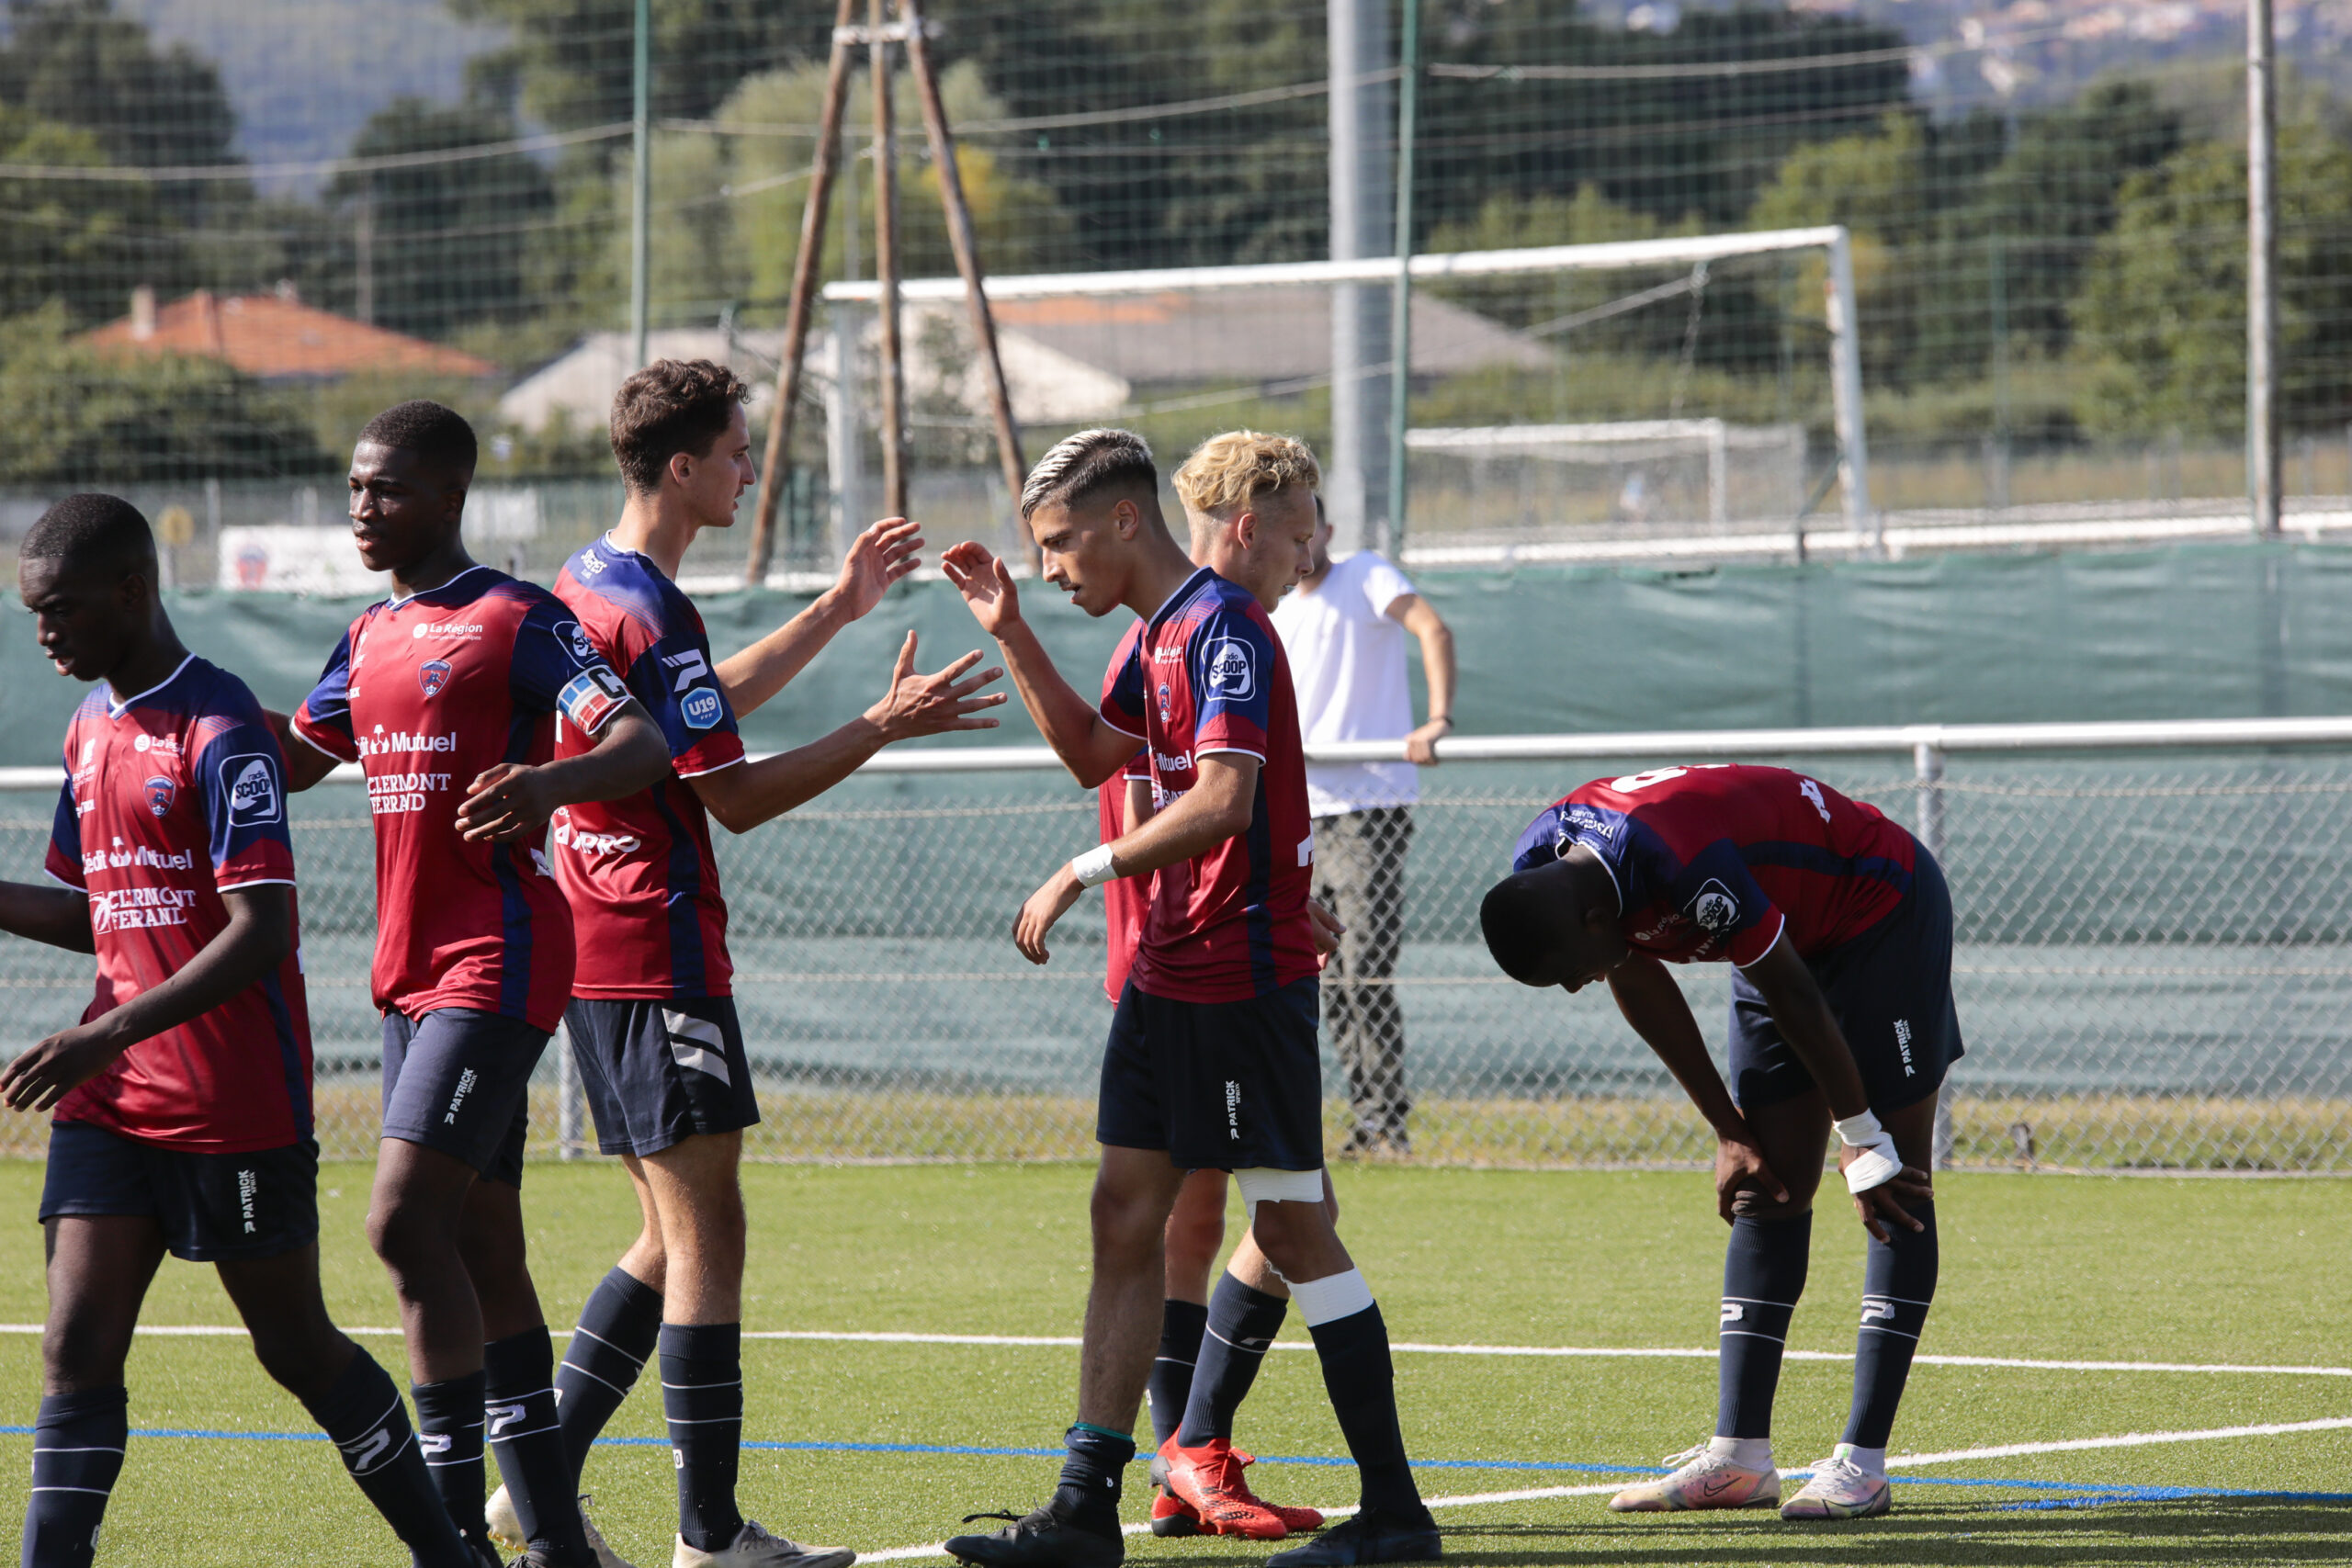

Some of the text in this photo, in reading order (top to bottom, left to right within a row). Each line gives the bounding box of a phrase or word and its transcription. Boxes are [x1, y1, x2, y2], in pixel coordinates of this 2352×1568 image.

[588, 667, 627, 699] C
[687, 696, 717, 716] U19
[390, 731, 457, 752] Mutuel
[1893, 1019, 1912, 1064] PATRICK
[449, 1067, 474, 1112] PATRICK
[1226, 1080, 1238, 1126] PATRICK
[238, 1169, 254, 1219] PATRICK
